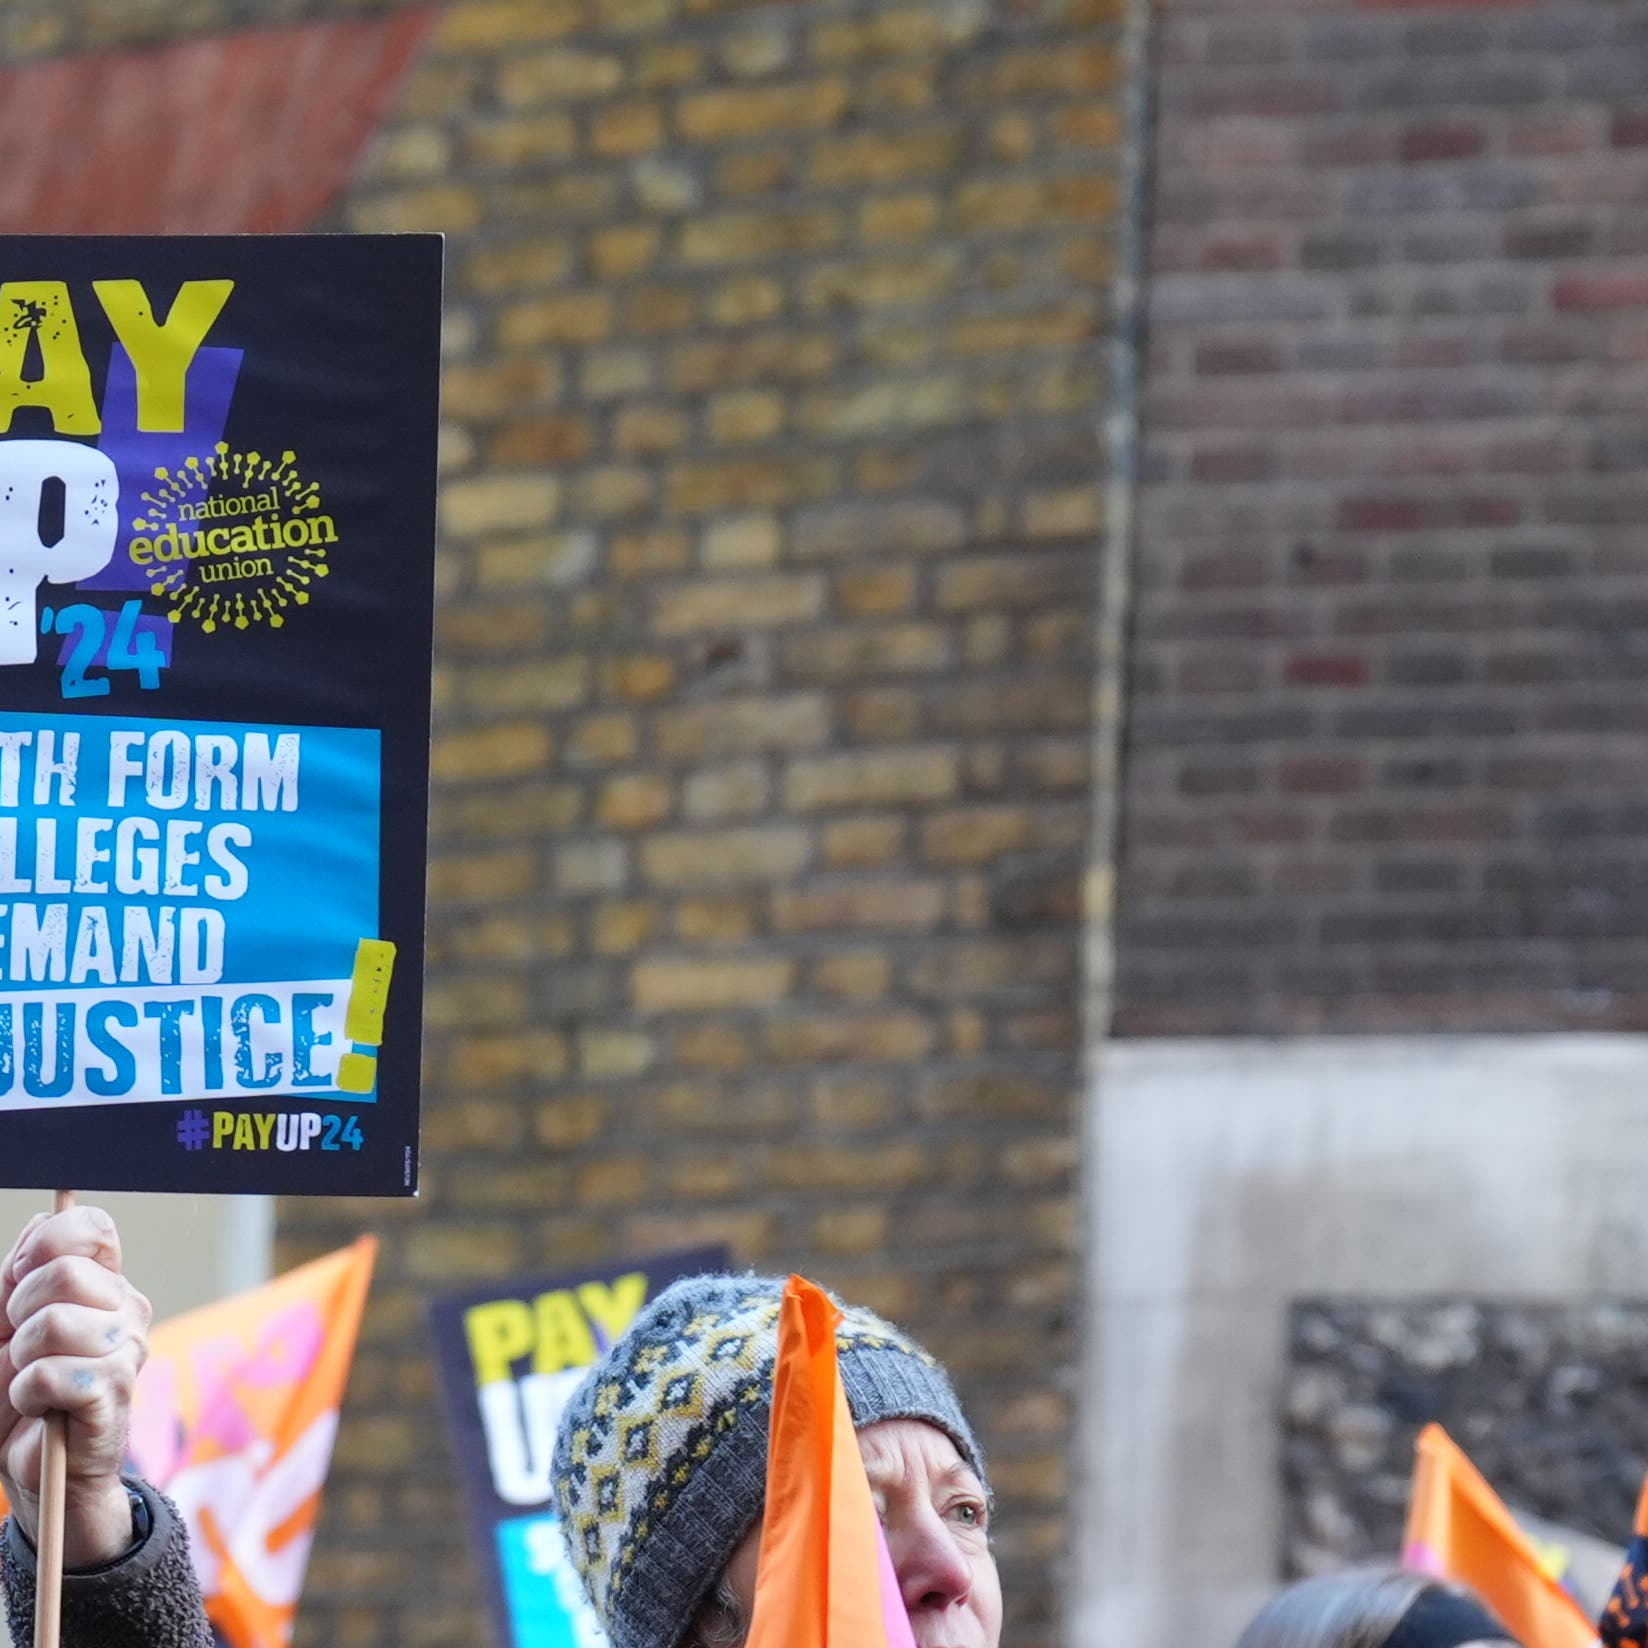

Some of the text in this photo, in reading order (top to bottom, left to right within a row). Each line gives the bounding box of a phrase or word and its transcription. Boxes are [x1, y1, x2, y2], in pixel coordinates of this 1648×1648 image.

[178, 488, 281, 523] national
[128, 512, 339, 568] education
[199, 554, 275, 584] union
[108, 730, 301, 813] FORM
[177, 1108, 364, 1152] #PAYUP24
[466, 1272, 649, 1387] PAY
[479, 1366, 594, 1507] U
